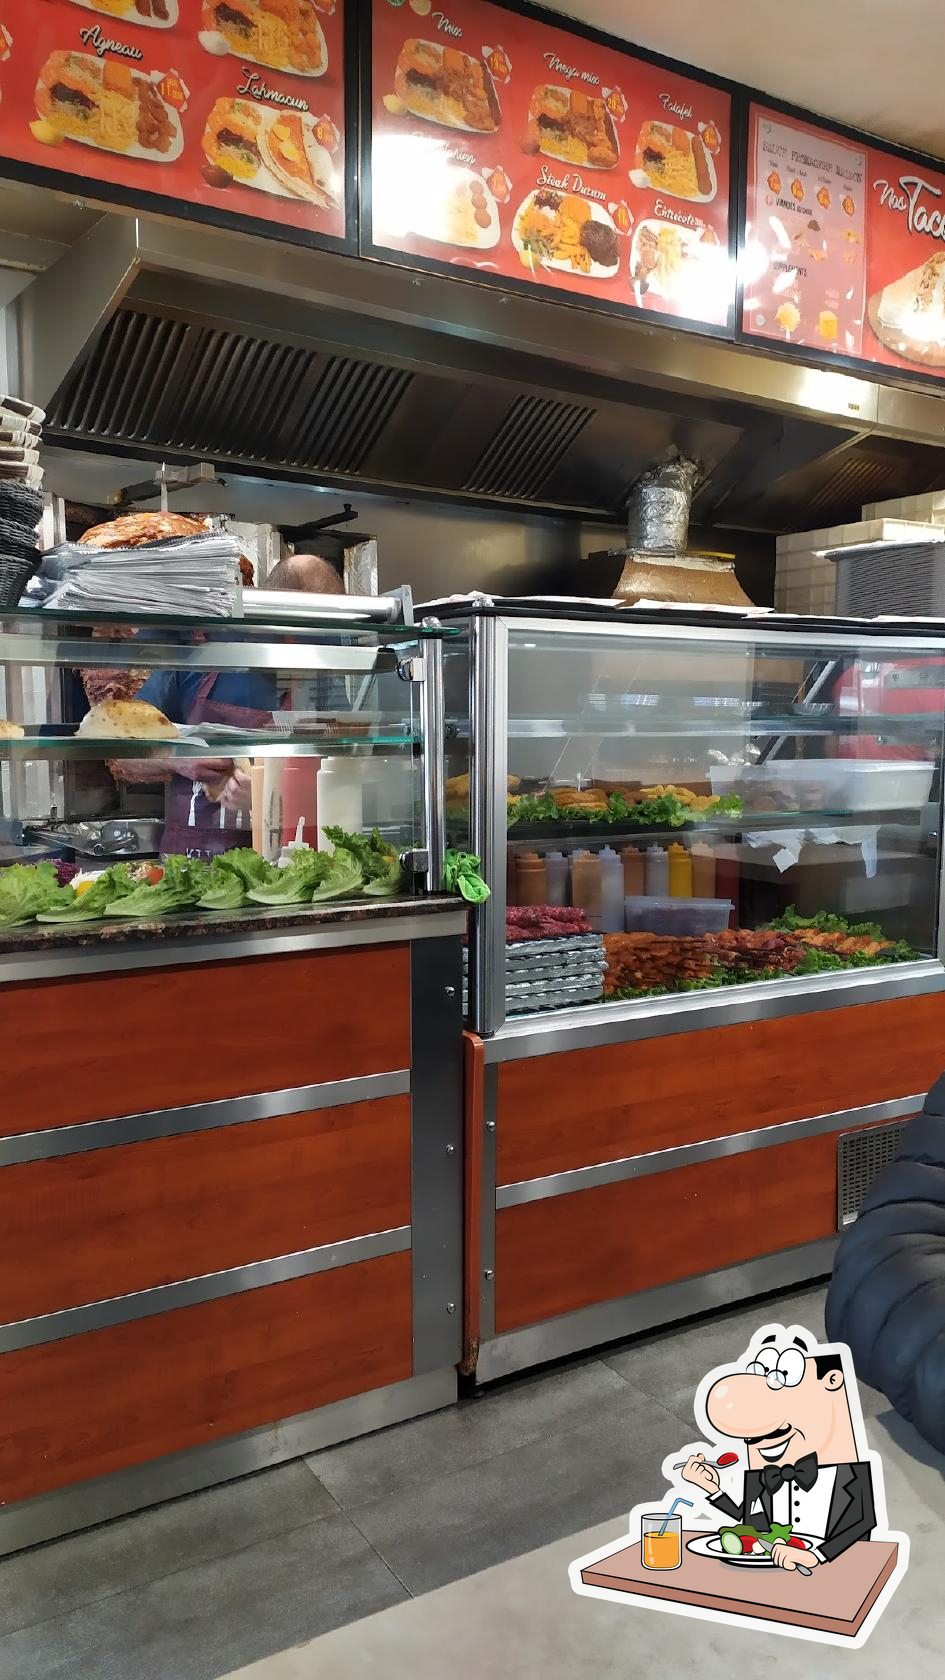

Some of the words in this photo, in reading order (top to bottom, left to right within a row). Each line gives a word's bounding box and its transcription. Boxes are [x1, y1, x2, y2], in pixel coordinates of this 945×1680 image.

[431, 11, 463, 37] Mix
[80, 24, 143, 59] Agneau
[544, 52, 579, 80] Mega
[581, 71, 600, 85] mix
[237, 66, 309, 110] Lahmacun
[658, 93, 693, 120] Falafel
[536, 165, 570, 189] Steak
[572, 173, 607, 200] Durum
[873, 179, 908, 212] Nos
